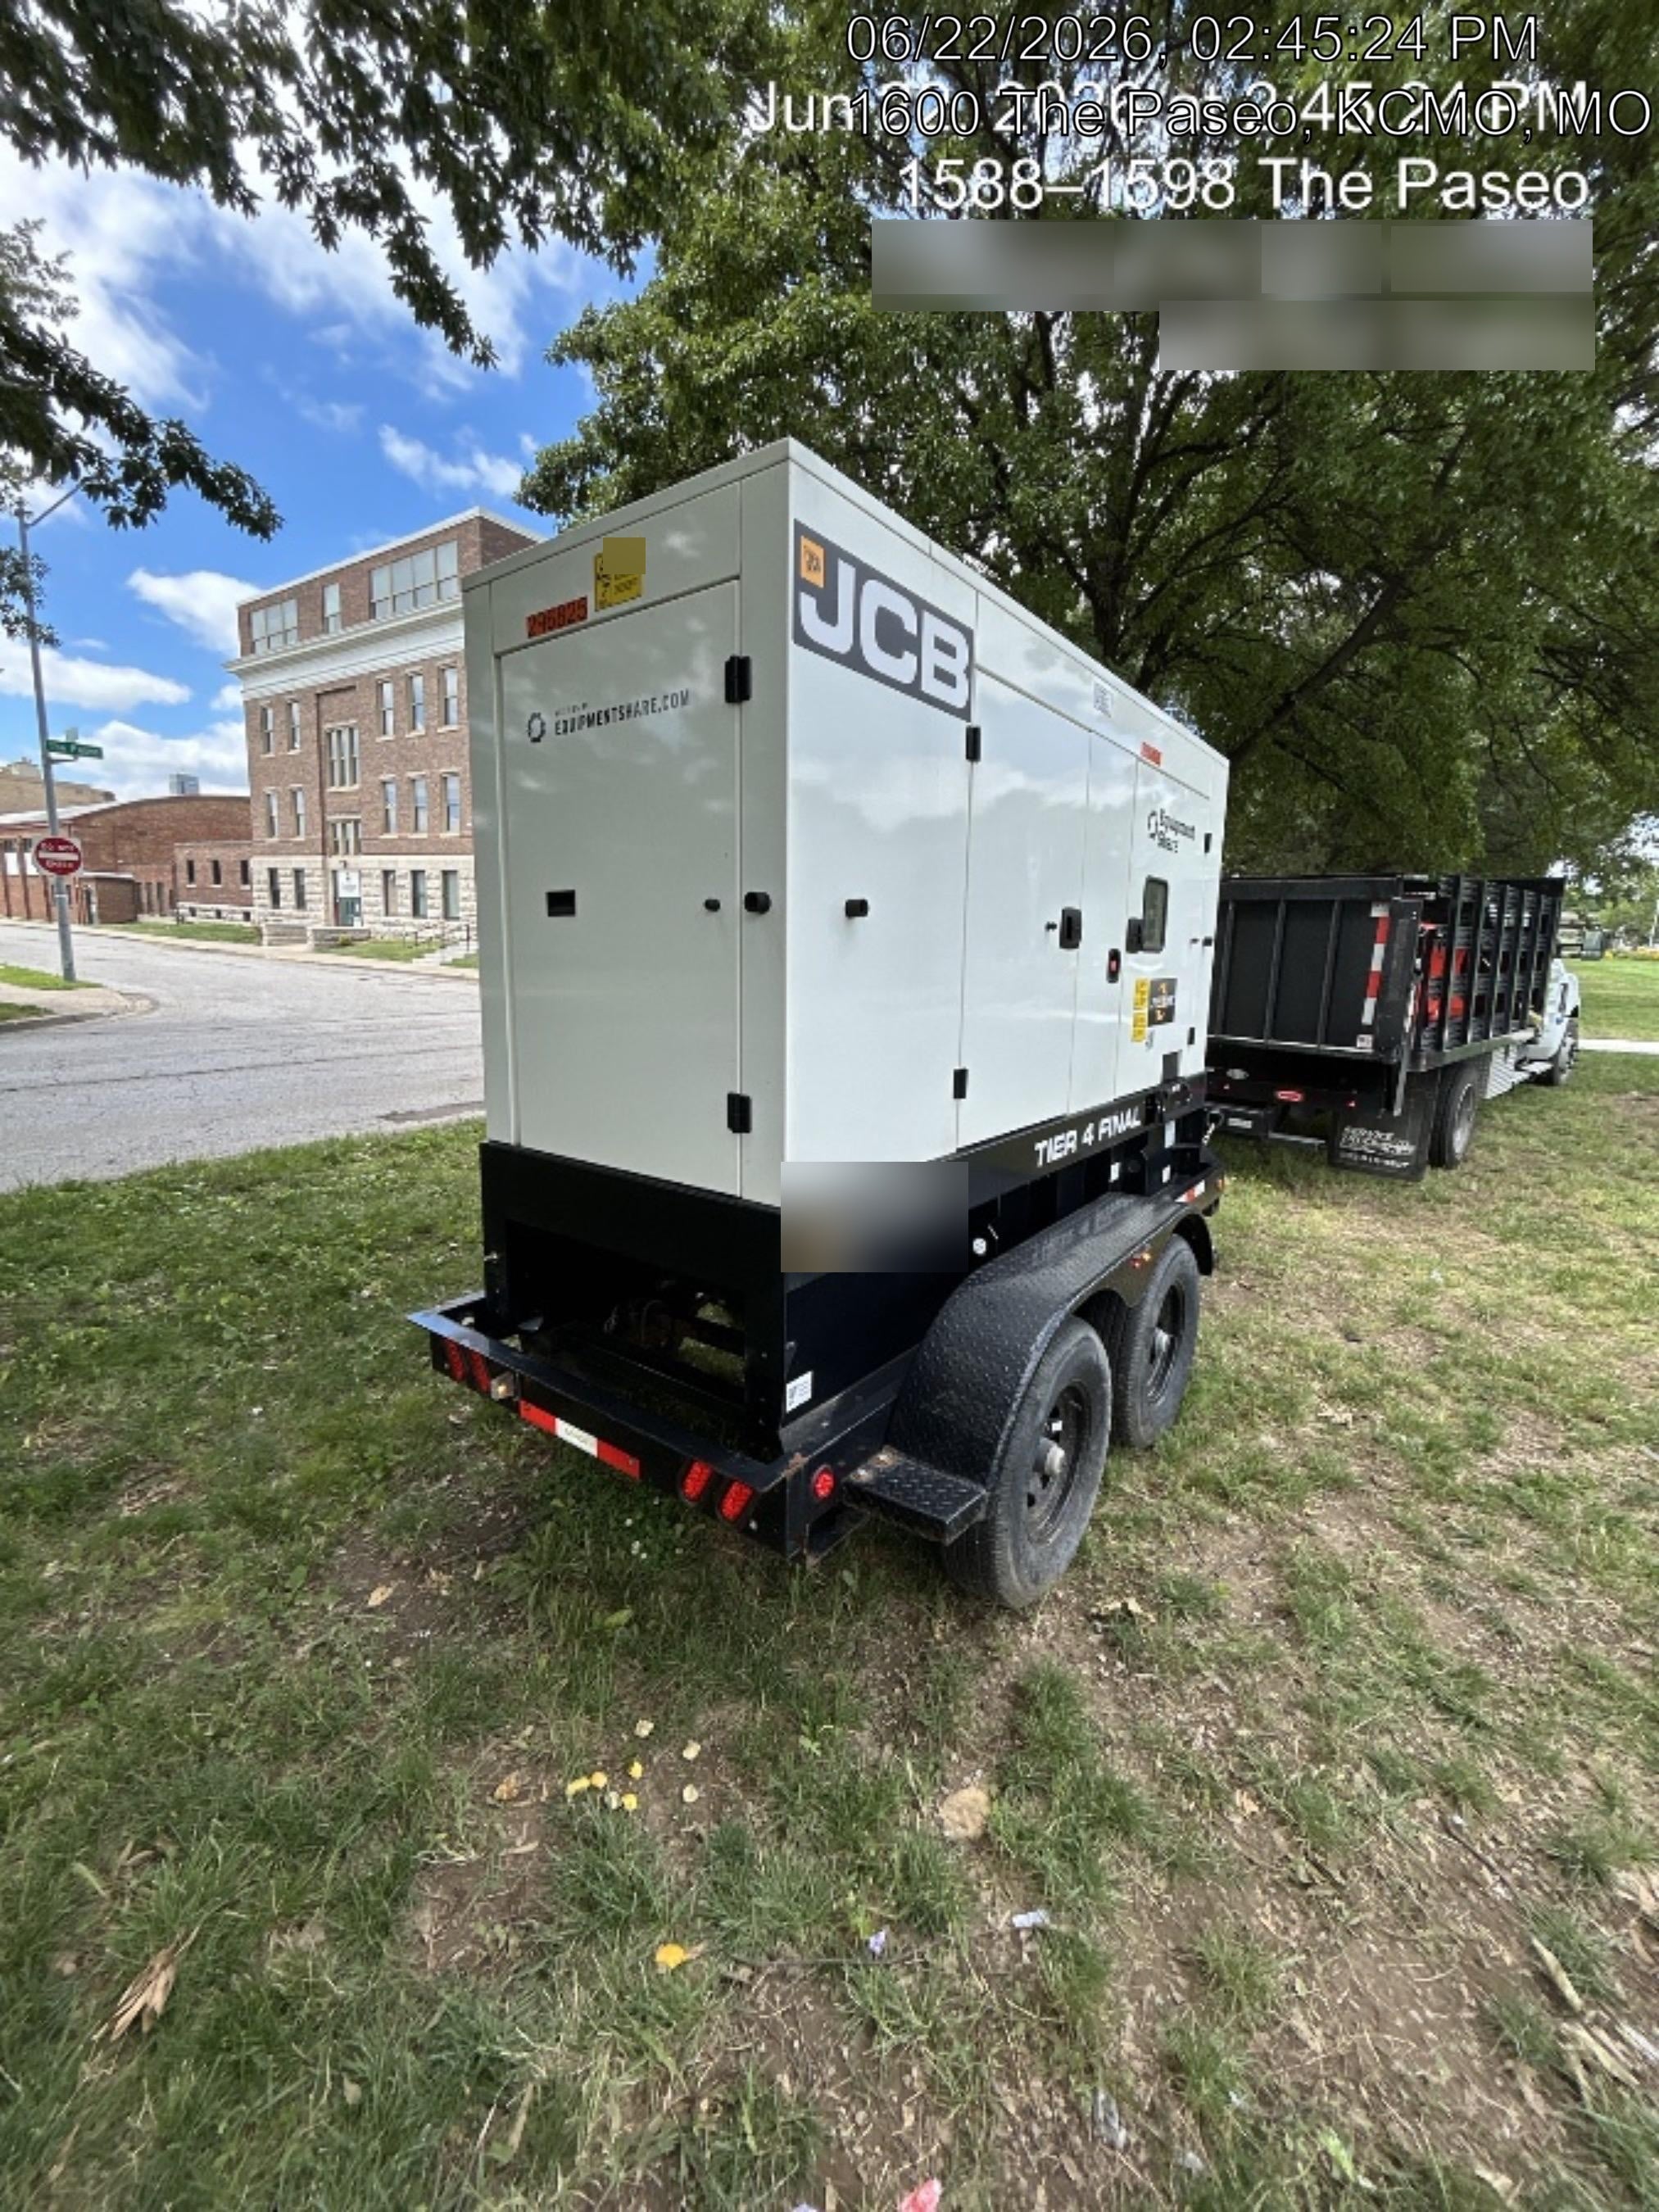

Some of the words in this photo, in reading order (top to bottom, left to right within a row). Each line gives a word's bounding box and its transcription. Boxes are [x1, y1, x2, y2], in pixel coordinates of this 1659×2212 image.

[799, 558, 970, 709] JCB
[555, 688, 690, 736] EQUIPMENTSHARE.COM
[1034, 1129, 1077, 1167] TIER
[1081, 1122, 1095, 1146] 4
[1098, 1106, 1141, 1142] FINAL
